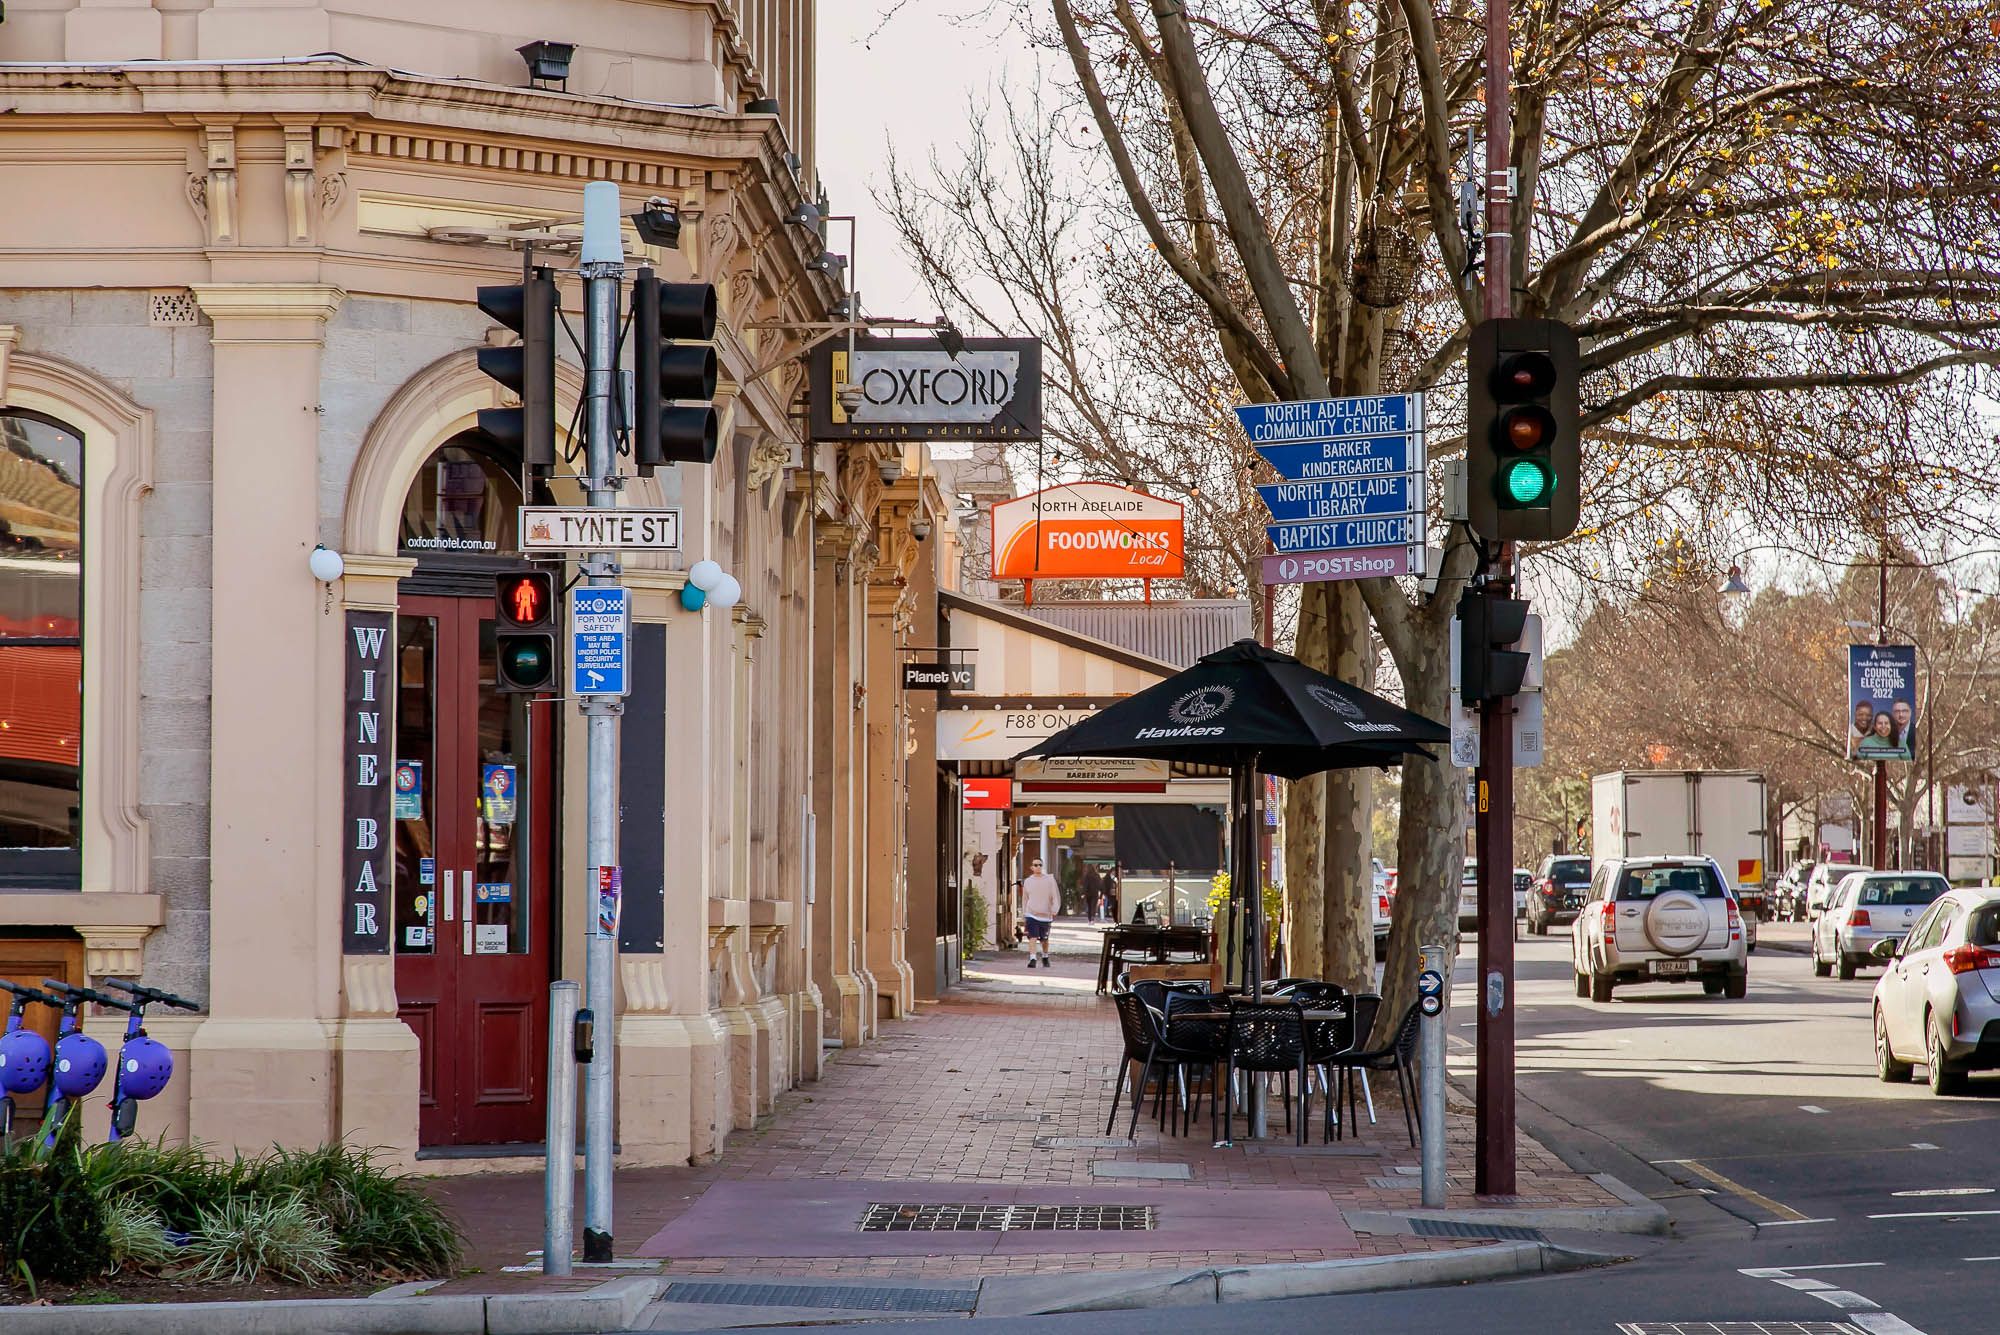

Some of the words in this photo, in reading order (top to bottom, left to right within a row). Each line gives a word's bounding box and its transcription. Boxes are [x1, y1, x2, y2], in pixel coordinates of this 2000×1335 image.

[862, 368, 1008, 405] OXFORD
[1265, 403, 1311, 423] NORTH
[1318, 398, 1386, 419] ADELAIDE
[852, 427, 907, 435] north
[927, 426, 1020, 435] adelaide
[1255, 419, 1336, 441] COMMUNITY
[1344, 415, 1398, 434] CENTRE
[1323, 441, 1371, 458] BARKER
[1302, 457, 1393, 477] KINDERGARTEN
[1278, 484, 1323, 502] NORTH
[1330, 478, 1398, 498] ADELAIDE
[1032, 502, 1077, 512] NORTH
[1081, 502, 1143, 512] ADELAIDE
[1308, 497, 1367, 517] LIBRARY
[560, 517, 633, 542] TYNTE
[641, 517, 670, 543] ST
[1279, 524, 1338, 549] BAPTIST
[1346, 519, 1407, 544] CHURCH
[408, 537, 496, 550] oxfordhotel.com.au
[1129, 551, 1168, 565] Local
[578, 615, 595, 623] FOR
[596, 615, 621, 623] YOUR
[583, 624, 615, 632] SAFETY
[906, 670, 949, 683] Planet
[951, 671, 971, 683] VC
[1864, 667, 1901, 678] COUNCIL
[1860, 678, 1905, 689] ELECTIONS
[1872, 688, 1893, 698] 2022
[353, 627, 387, 786] WINE
[1135, 726, 1225, 739] Hawkers
[354, 818, 379, 935] BAR
